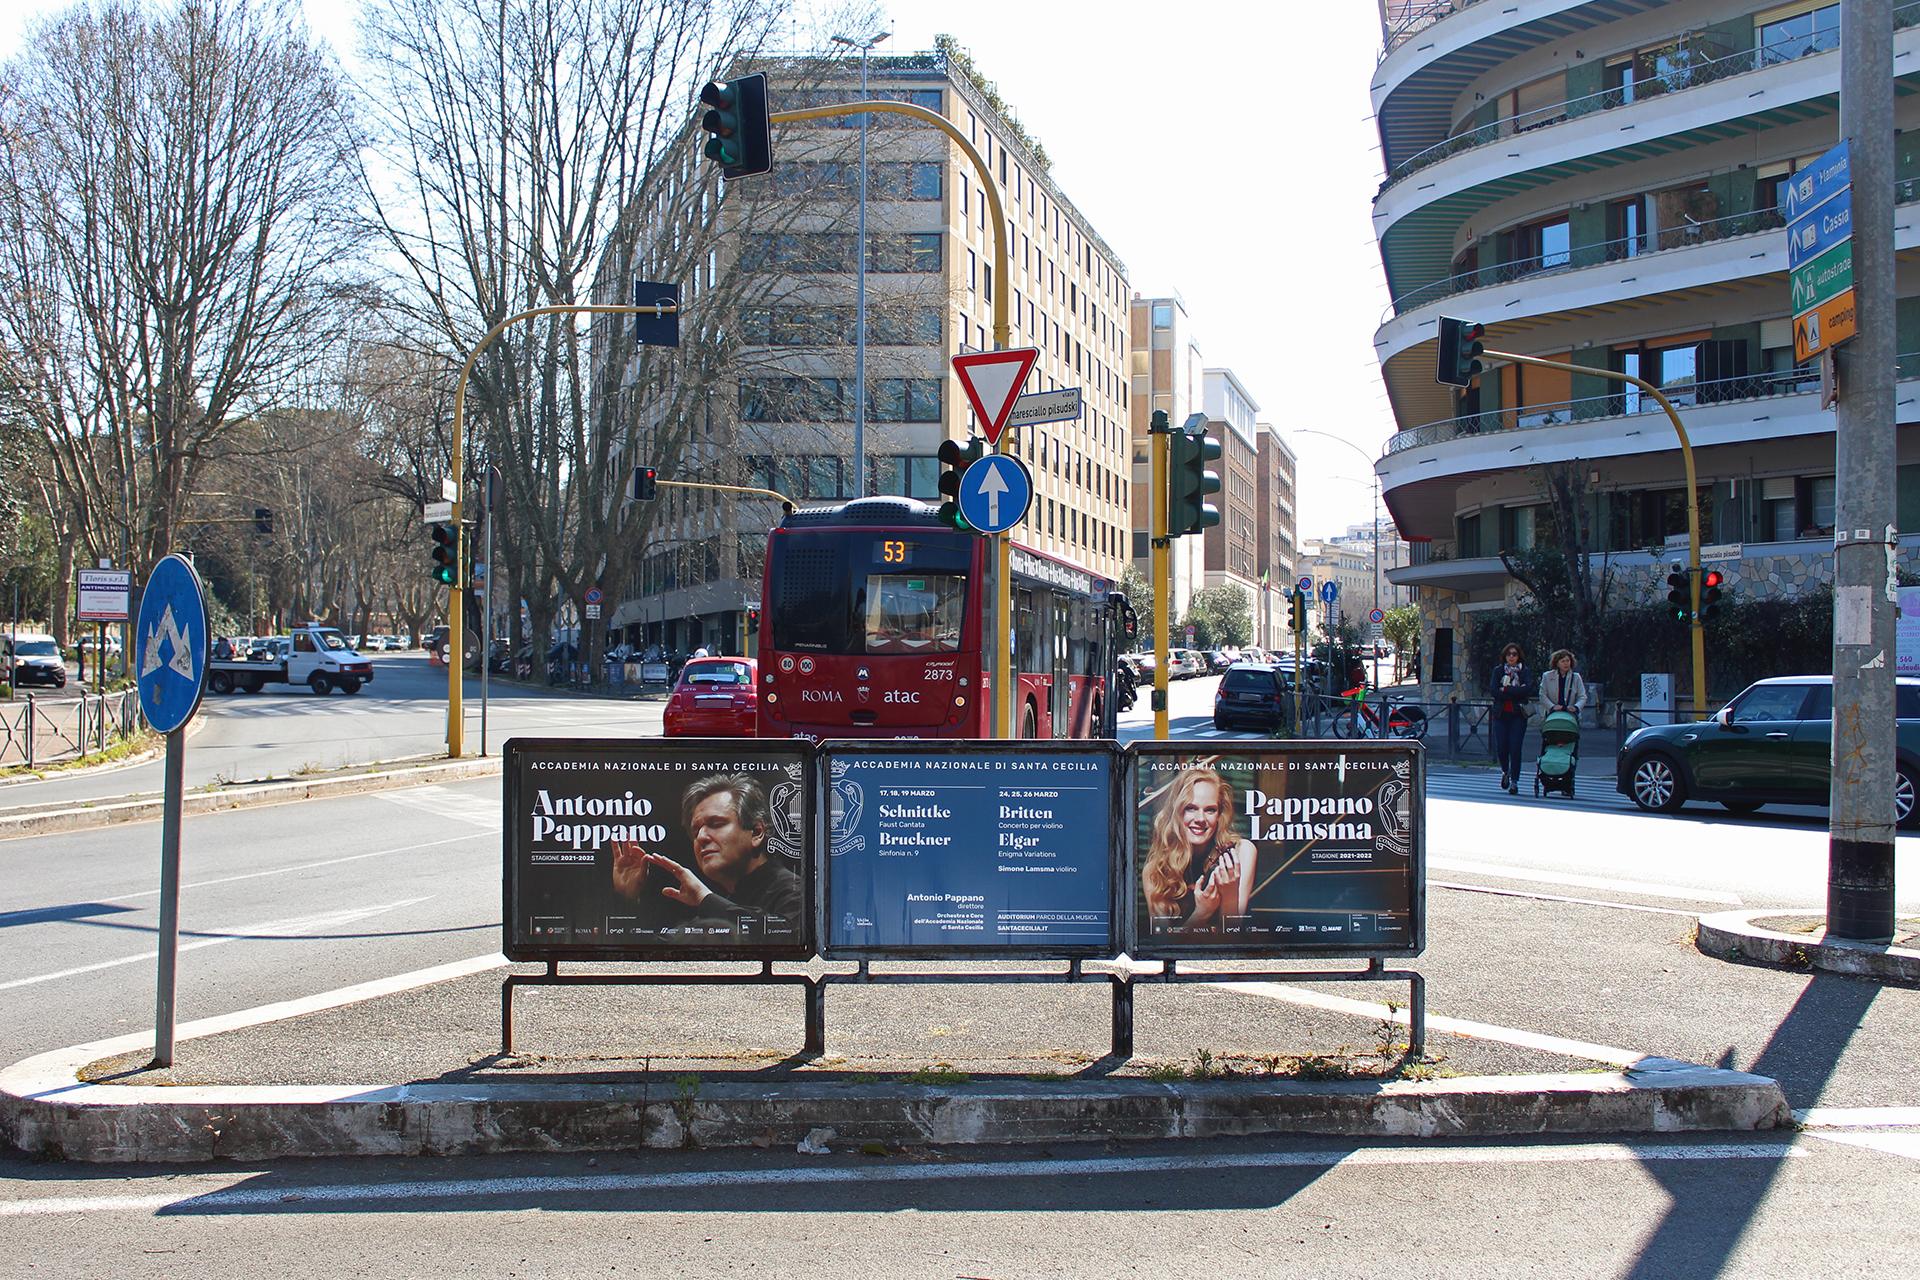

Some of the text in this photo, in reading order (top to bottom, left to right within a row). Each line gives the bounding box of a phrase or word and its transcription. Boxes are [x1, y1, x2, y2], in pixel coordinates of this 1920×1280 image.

[1823, 209, 1849, 234] Cassia
[1817, 257, 1851, 287] autostrade
[1829, 307, 1853, 329] camping
[1048, 401, 1077, 417] pilsudski
[884, 541, 905, 563] 53
[783, 660, 792, 668] 80
[802, 662, 812, 670] 100
[924, 670, 953, 681] 2873
[802, 690, 842, 702] ROMA
[884, 690, 920, 703] atac
[531, 762, 779, 771] ACCADEMIA NAZIONALE DI SANTA CECILIA
[854, 761, 1098, 770] ACCADEMIA NAZIONALE DI SANTA CECILIA
[1151, 762, 1389, 771] ACCADEMIA NAZIONALE DI SANTA CECILIA
[531, 790, 652, 816] Antonio
[1245, 790, 1373, 822] Pappano
[880, 804, 951, 818] Schnittke
[1000, 805, 1052, 819] Britten
[532, 816, 666, 849] Pappano
[1250, 816, 1372, 841] Lamsma
[880, 832, 951, 846] Bruckner
[1000, 833, 1039, 850] Elgar
[907, 893, 984, 903] Antonio Pappano
